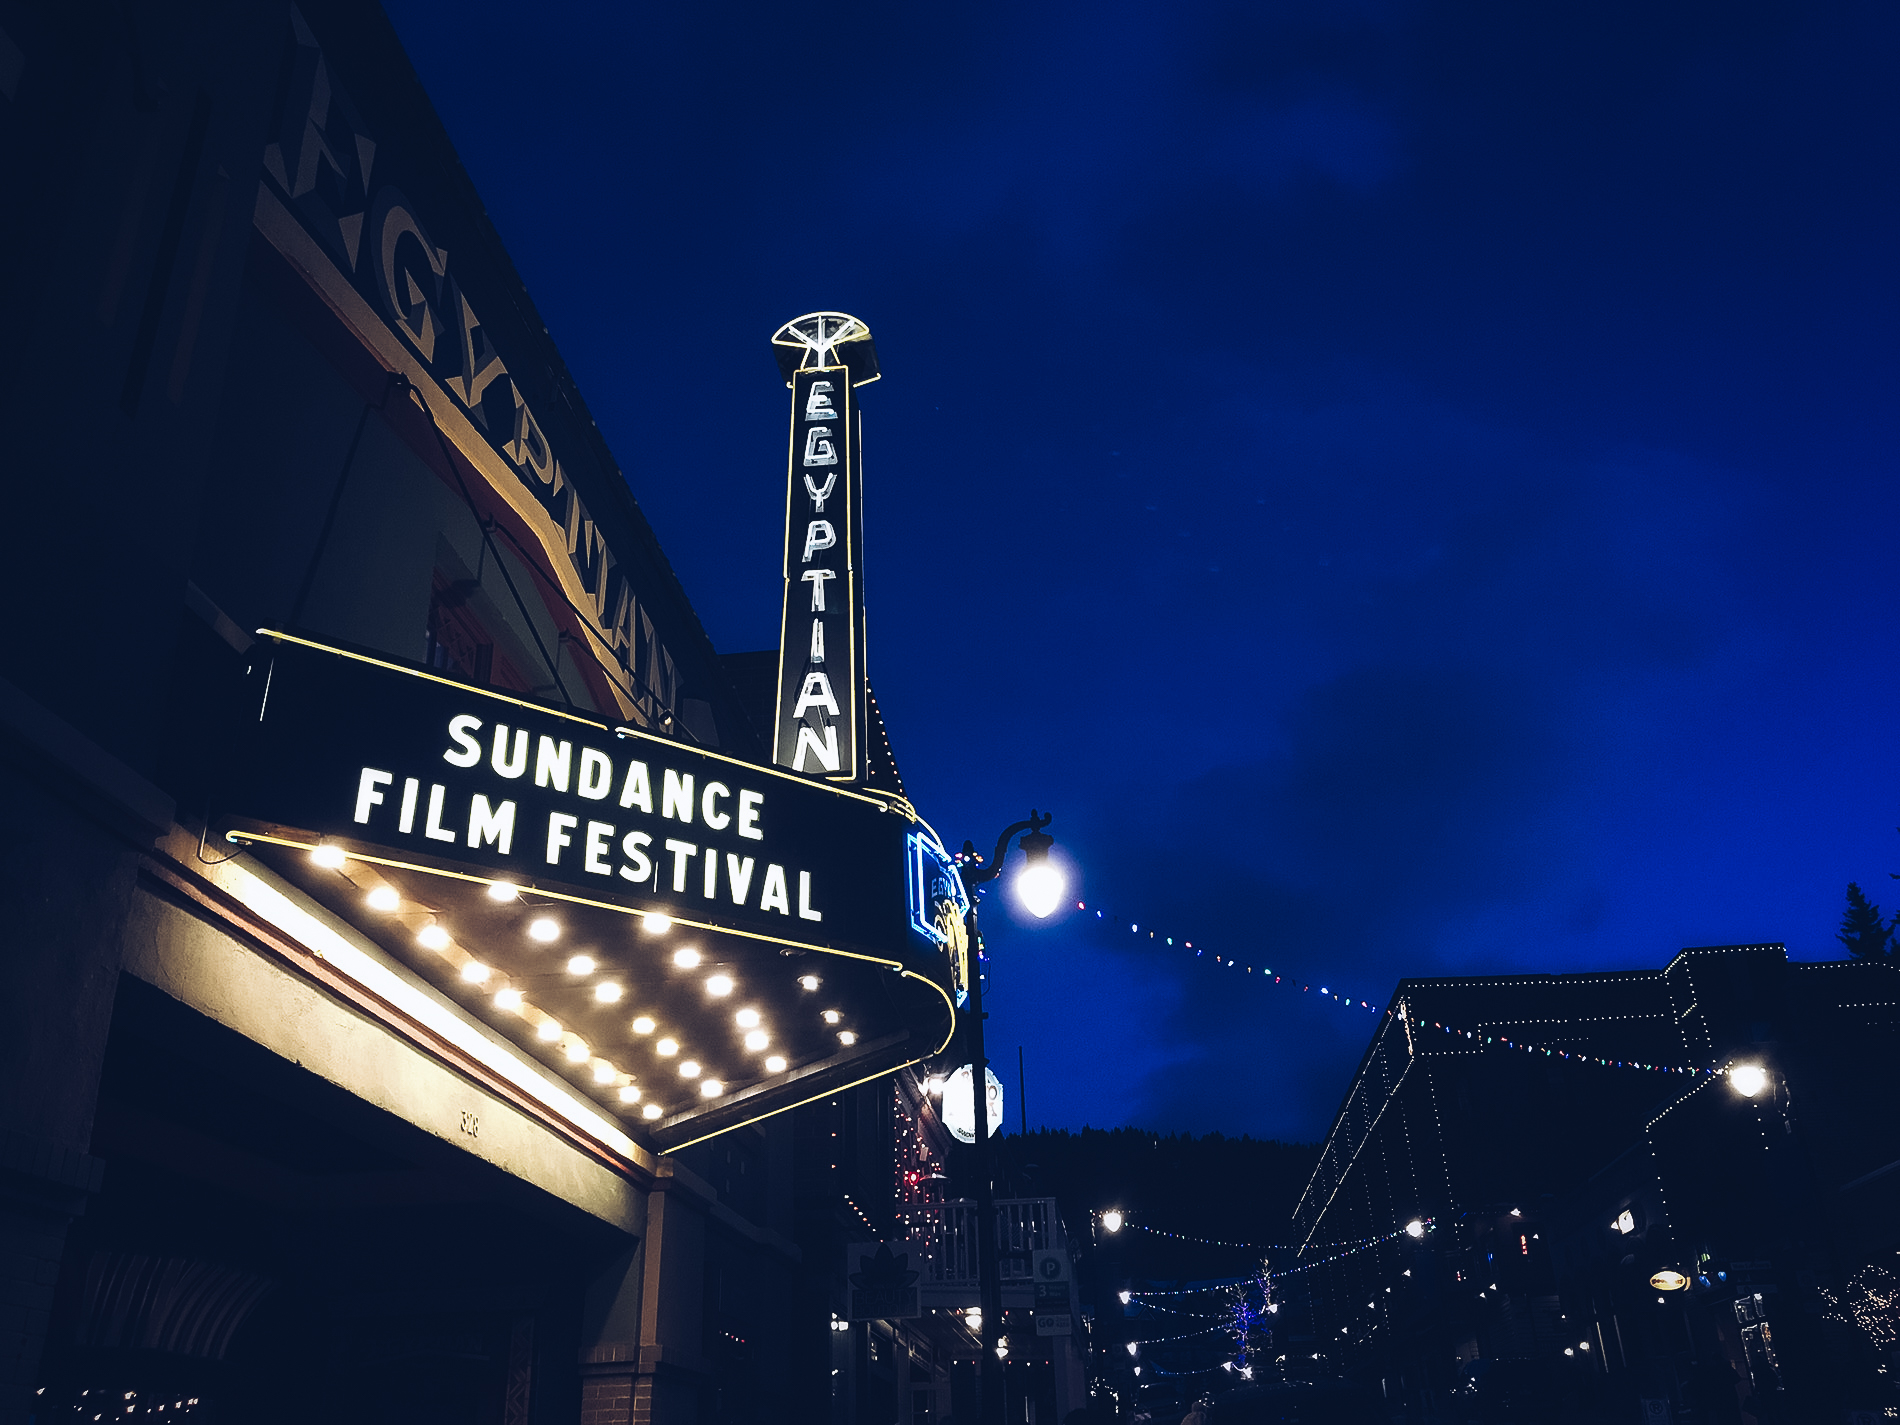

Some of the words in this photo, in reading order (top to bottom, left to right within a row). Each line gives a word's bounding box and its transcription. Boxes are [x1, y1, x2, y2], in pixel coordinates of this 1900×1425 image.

[262, 0, 684, 736] EGYPTIAN
[791, 381, 842, 772] EGYPTIAN
[442, 713, 765, 841] SUNDANCE
[353, 765, 518, 855] FILM
[544, 810, 823, 922] FESTIVAL
[460, 1110, 480, 1138] 328
[854, 1288, 915, 1305] BEAUTY
[854, 1303, 915, 1317] BOUTIQUE
